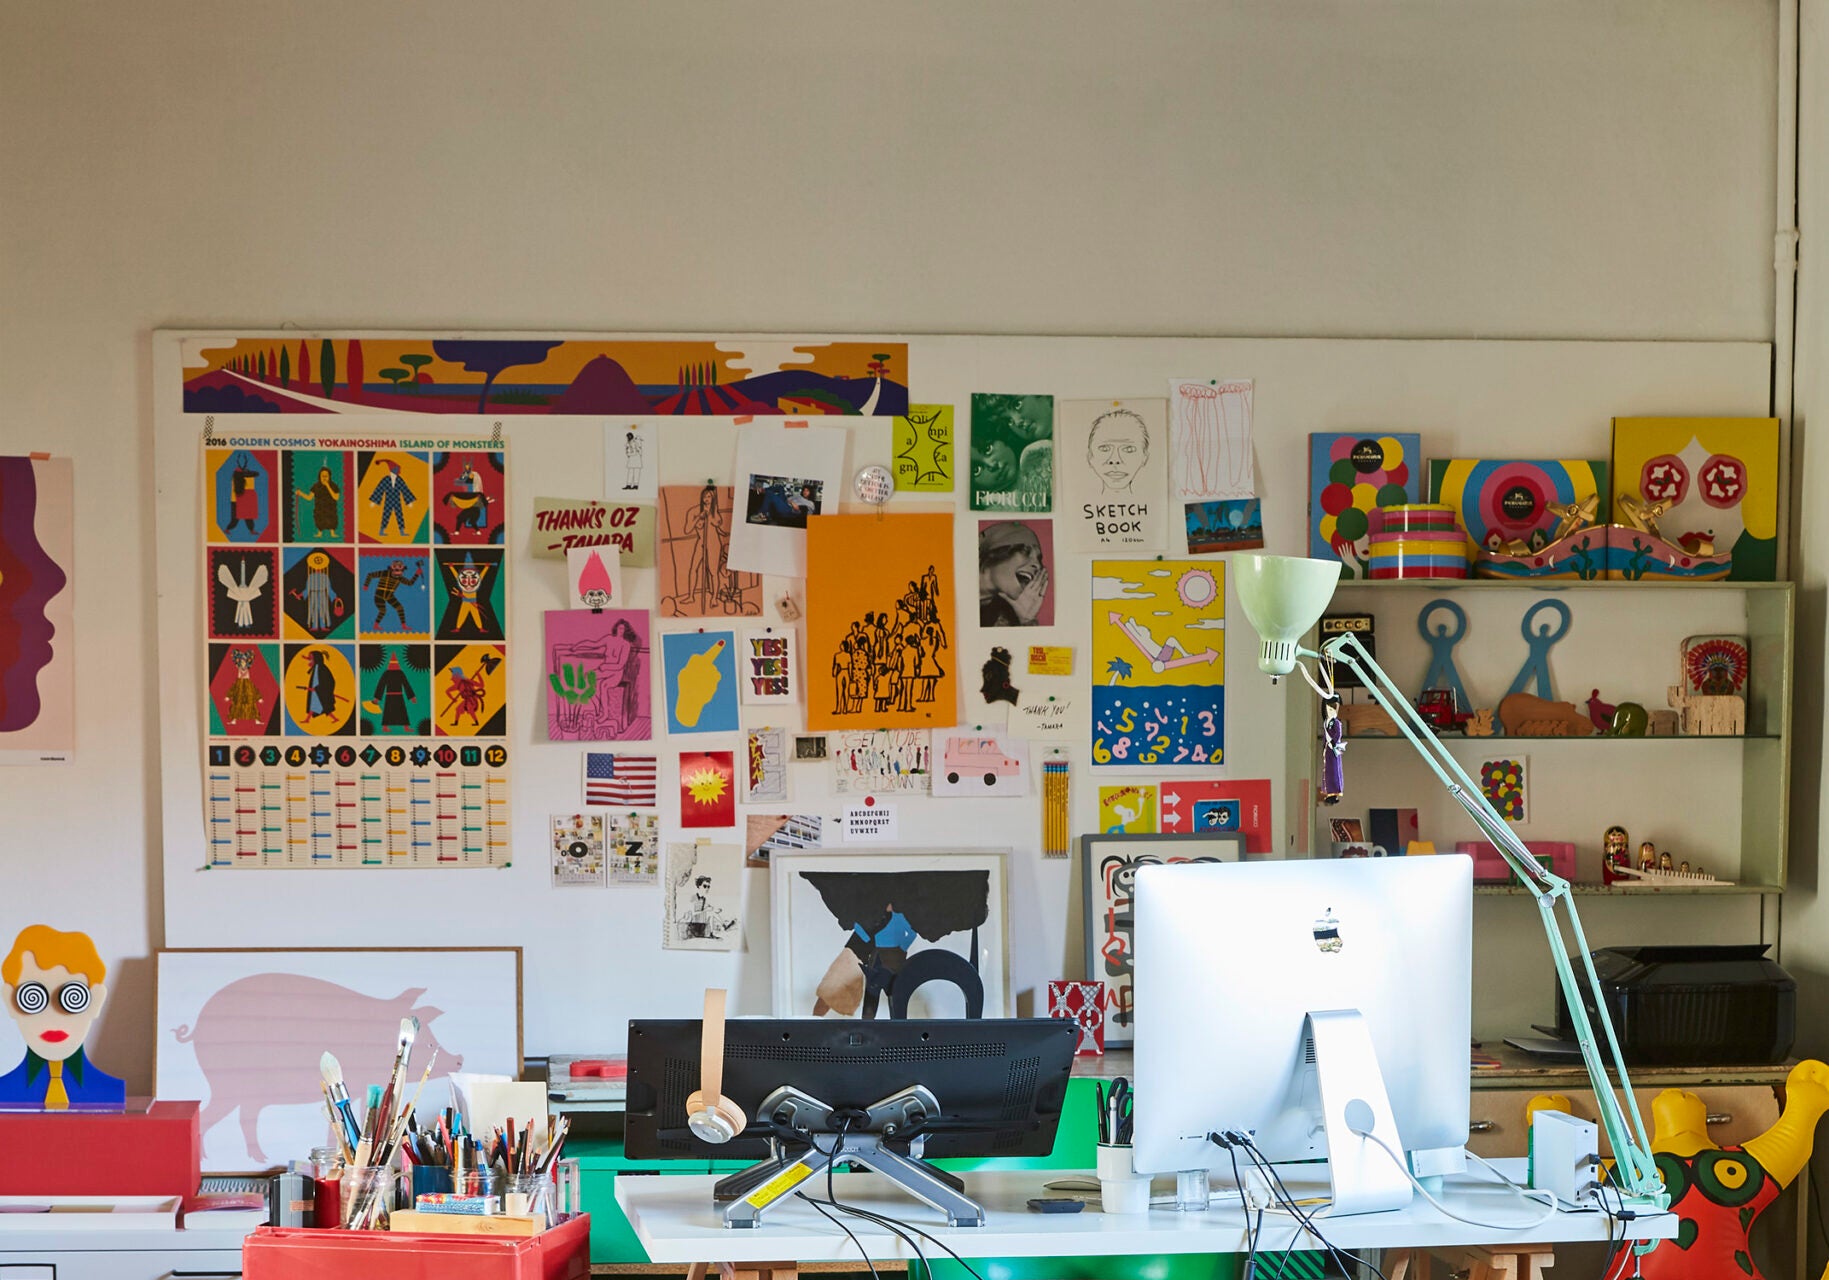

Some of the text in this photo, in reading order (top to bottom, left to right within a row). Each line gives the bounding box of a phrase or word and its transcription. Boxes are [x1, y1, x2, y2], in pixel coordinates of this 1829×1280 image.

[205, 438, 505, 449] 2016 GOLDEN COSMOS YOKAINOSHIMA ISLAND OF MONSTERS
[536, 507, 640, 532] THANKS OZ
[1083, 504, 1148, 519] SKETCH
[1096, 521, 1142, 535] BOOK
[750, 637, 788, 657] YES!
[750, 657, 789, 676] YES!
[750, 676, 789, 695] YES!
[216, 750, 504, 762] 1 2 3 4 5 6 7 8 9 10 11 12
